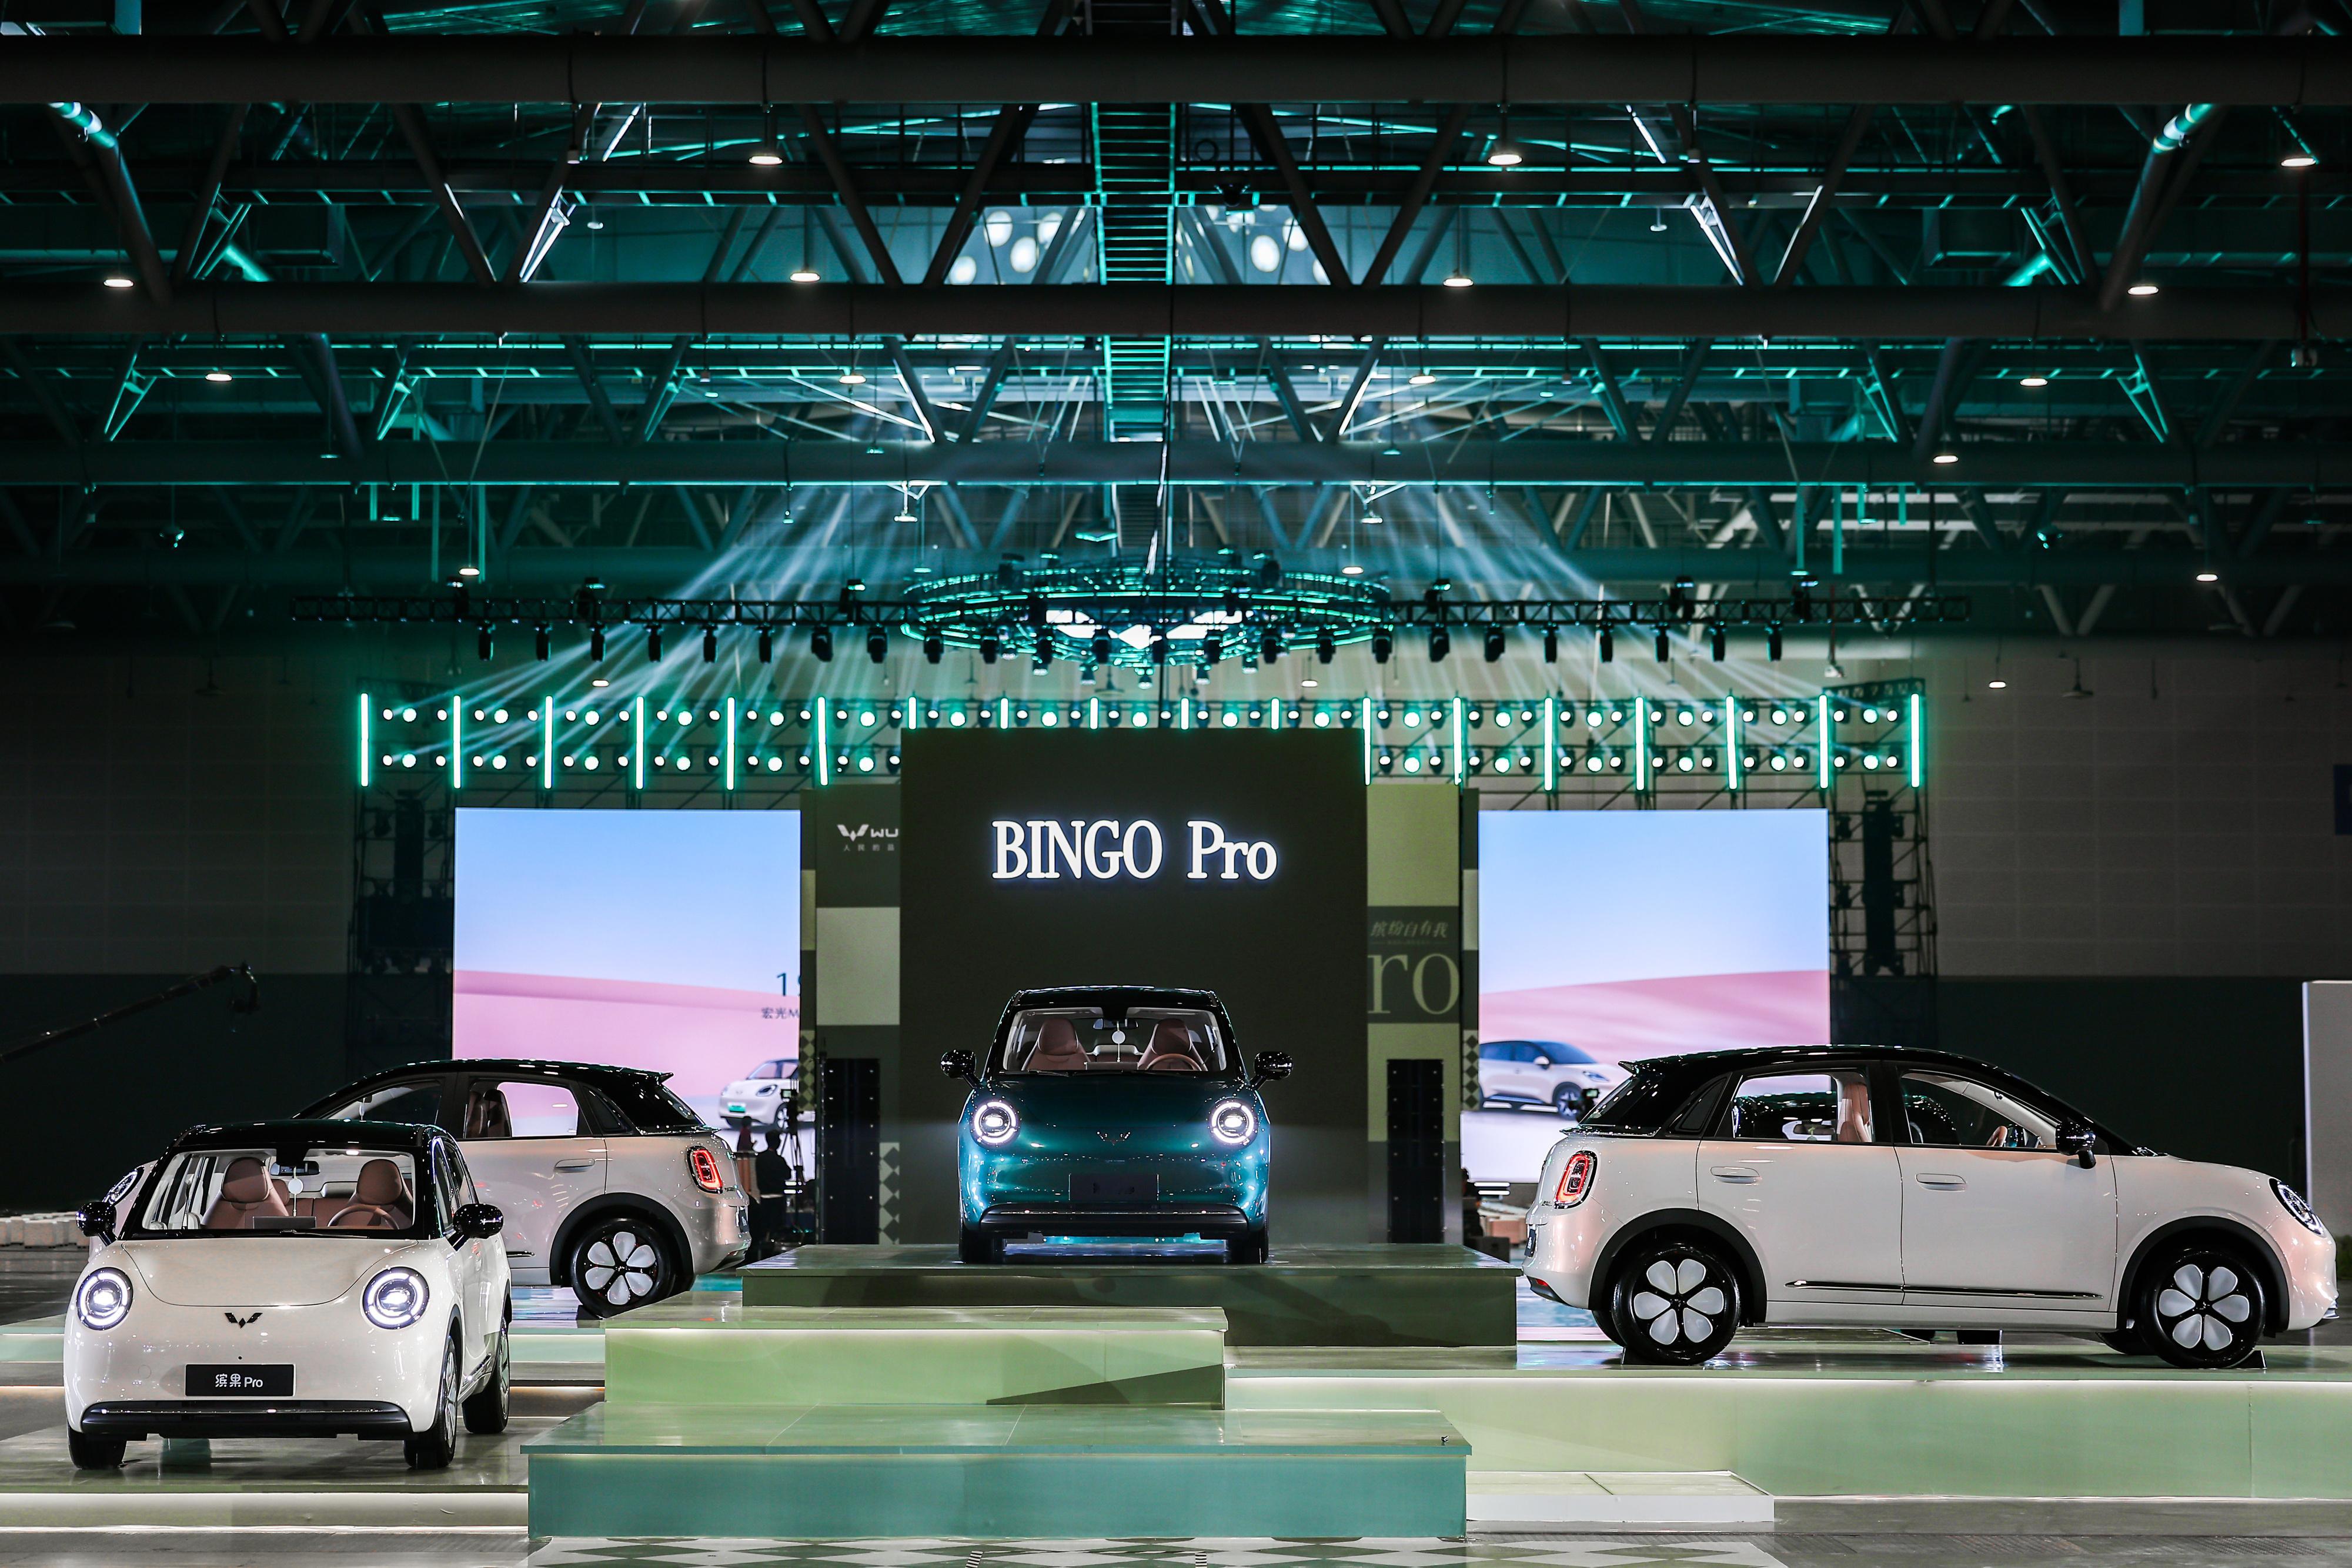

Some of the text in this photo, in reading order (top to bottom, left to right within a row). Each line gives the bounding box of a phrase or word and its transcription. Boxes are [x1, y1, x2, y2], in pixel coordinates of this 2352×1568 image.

[992, 820, 1278, 880] BINGO Pro
[244, 1376, 263, 1388] Pro
